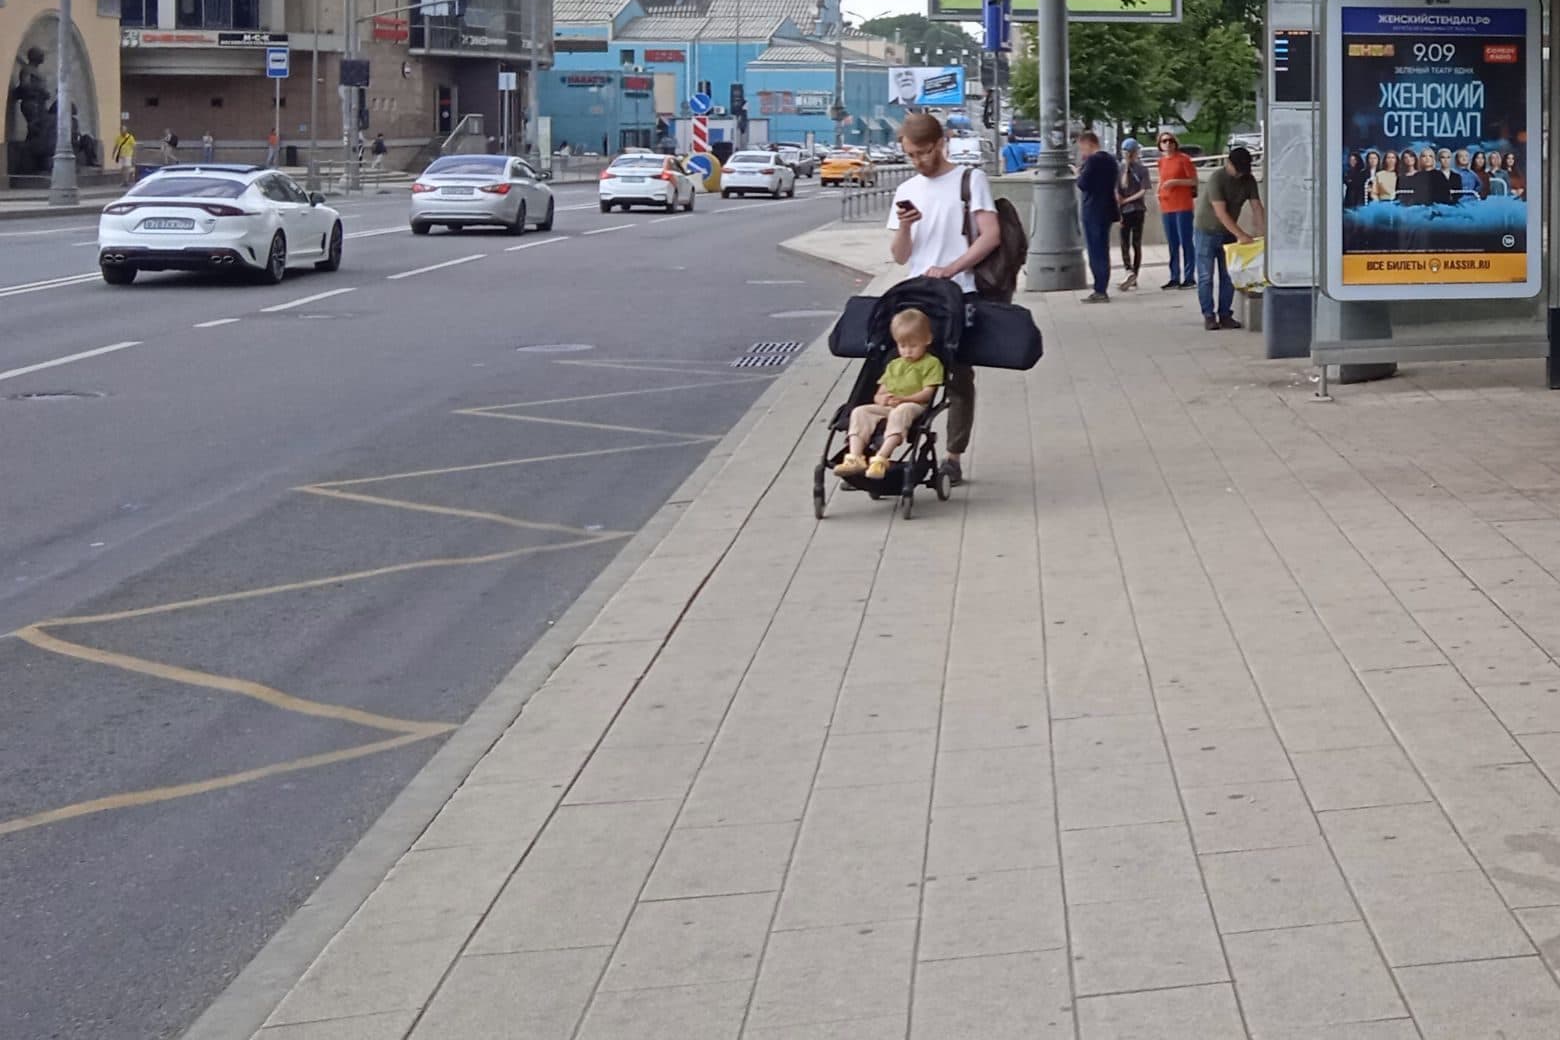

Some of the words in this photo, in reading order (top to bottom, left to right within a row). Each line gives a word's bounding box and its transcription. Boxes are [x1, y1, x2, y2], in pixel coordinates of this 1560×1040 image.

[1378, 14, 1491, 25] ЖЕНСКИЙСТЕНДАП.РФ
[1413, 43, 1455, 62] 9.09
[1379, 80, 1484, 109] ЖЕНСКИЙ
[1383, 111, 1481, 137] СТЕНДАП
[1367, 260, 1384, 271] ВСЕ
[1387, 260, 1426, 271] БИЛЕТЫ
[1443, 260, 1490, 270] KASSIR.RU
